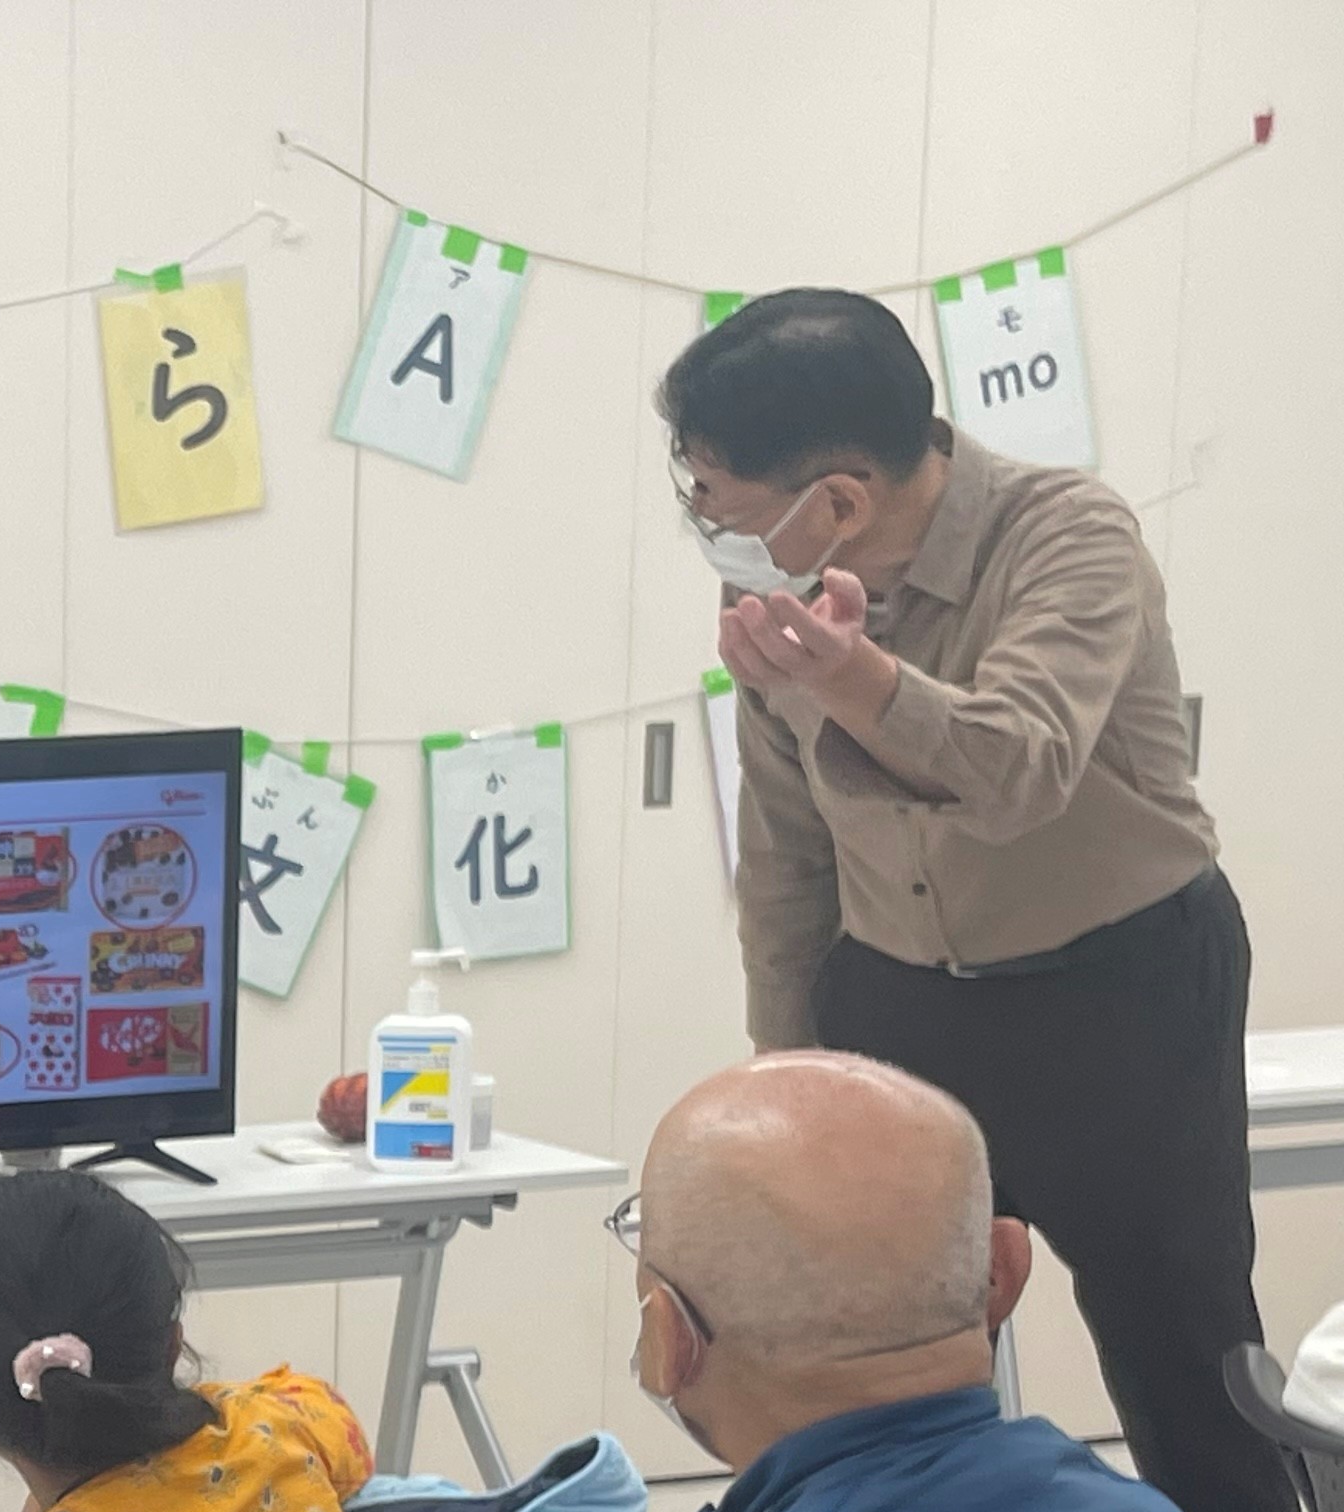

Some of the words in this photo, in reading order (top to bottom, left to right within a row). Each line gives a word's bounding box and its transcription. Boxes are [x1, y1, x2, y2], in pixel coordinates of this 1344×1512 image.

[449, 266, 471, 289] ア
[152, 328, 228, 451] ら
[391, 312, 453, 404] A
[980, 351, 1057, 408] mo
[238, 833, 304, 935] 文
[454, 812, 540, 906] 化
